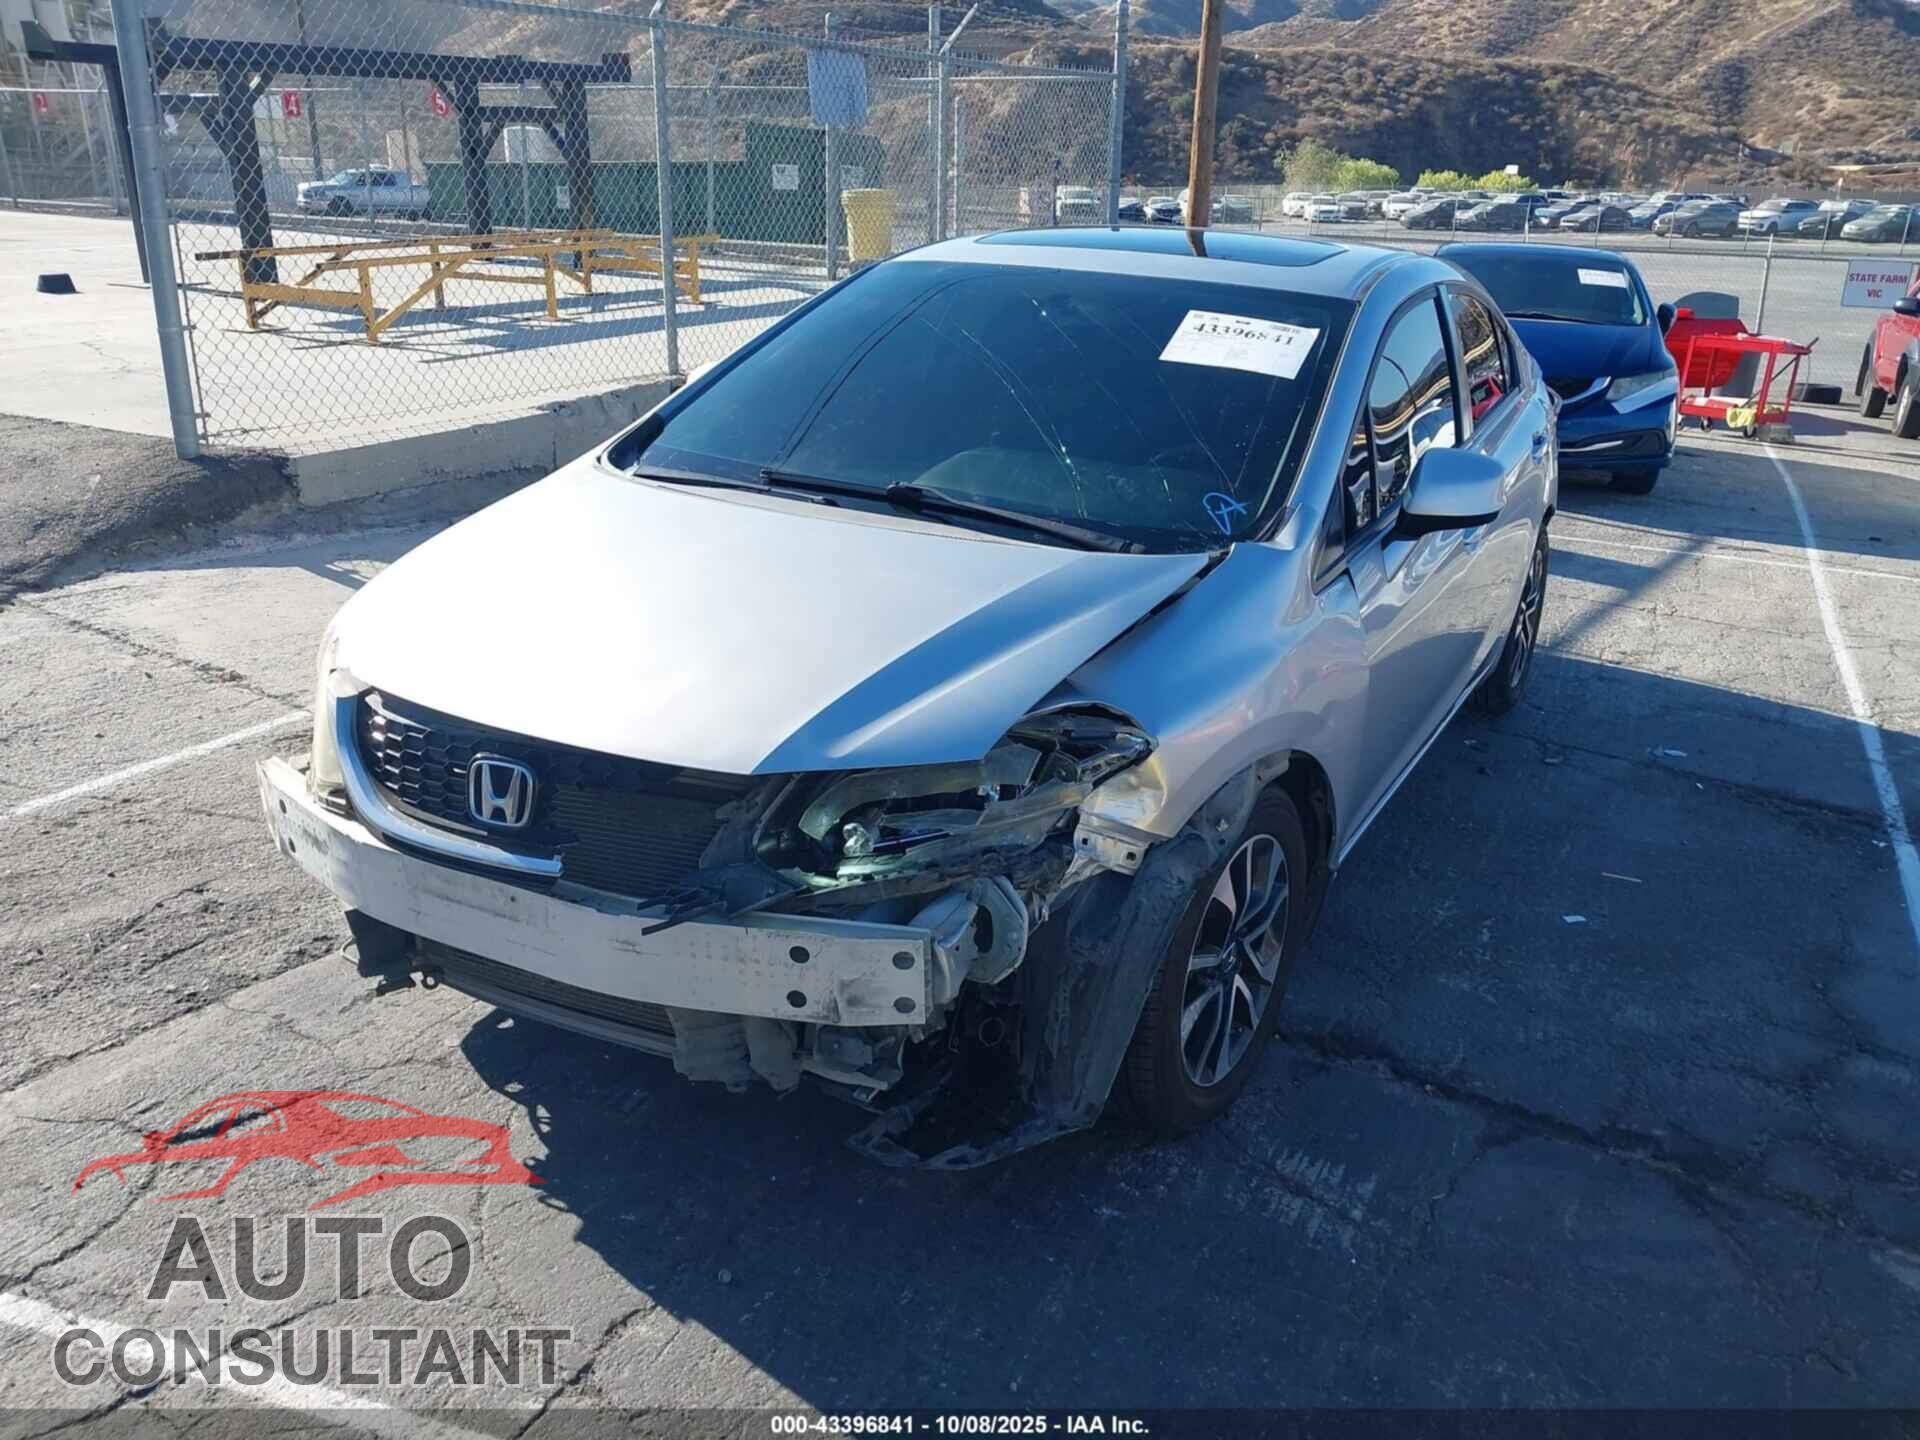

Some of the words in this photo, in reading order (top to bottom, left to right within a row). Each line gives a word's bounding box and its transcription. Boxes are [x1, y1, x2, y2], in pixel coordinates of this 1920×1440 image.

[435, 91, 447, 114] 5
[1849, 272, 1877, 283] STATE
[1880, 273, 1908, 284] FARM
[1867, 288, 1882, 298] VIC
